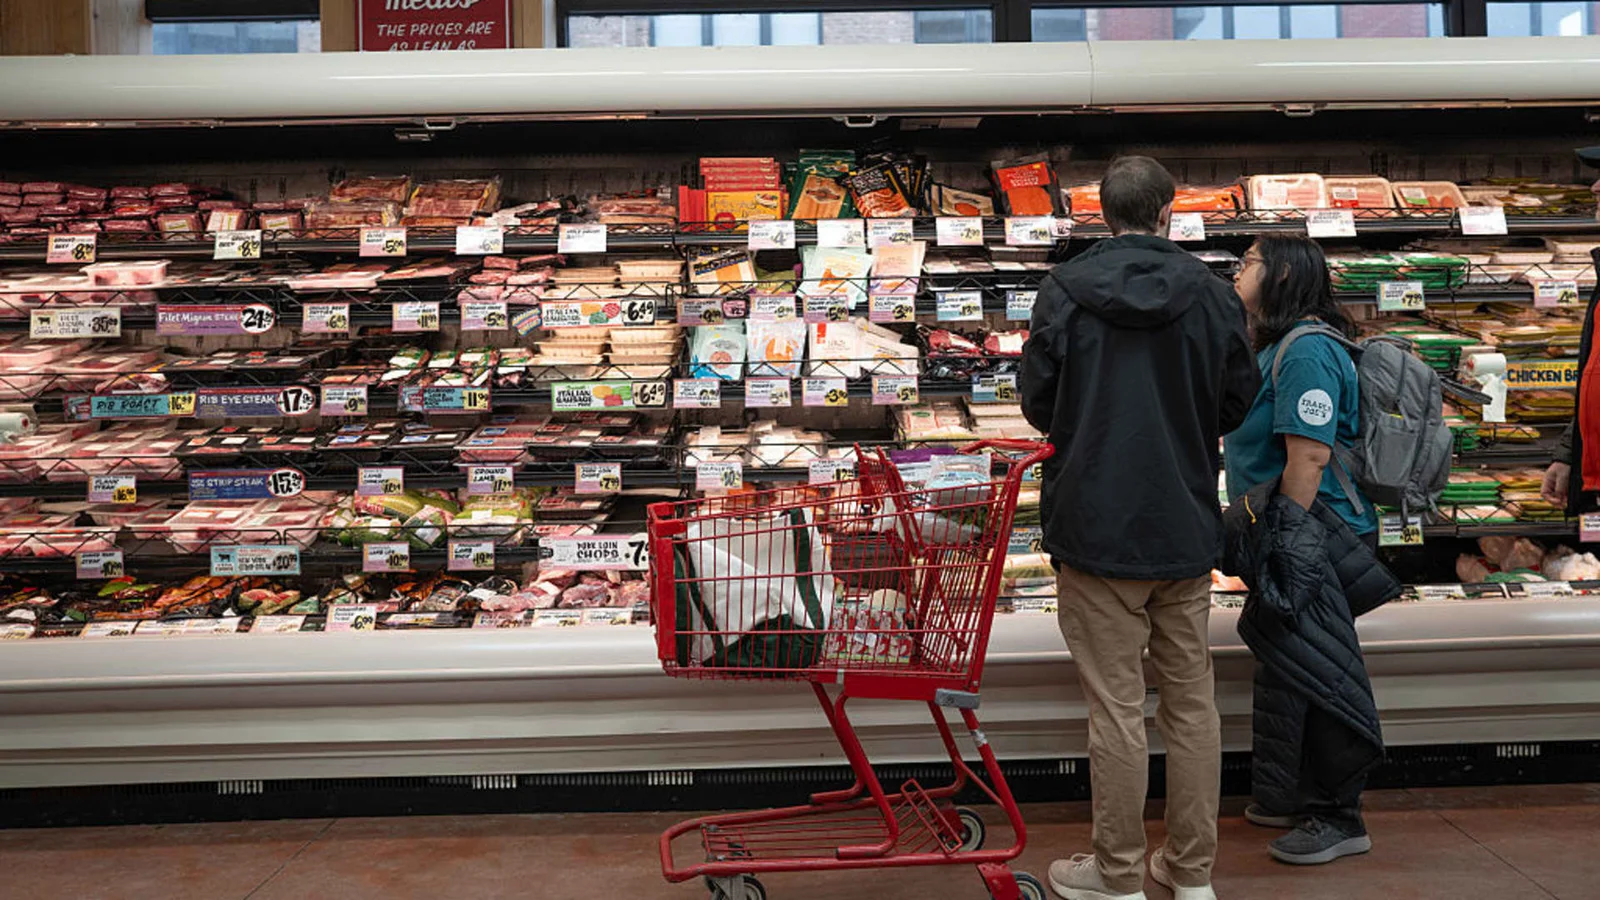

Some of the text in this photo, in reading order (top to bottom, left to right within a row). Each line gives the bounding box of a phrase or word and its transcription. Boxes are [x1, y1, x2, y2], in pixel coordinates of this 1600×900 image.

[376, 21, 495, 36] THE PRICES ARE
[389, 40, 476, 51] AS LEAN AS
[159, 312, 180, 323] Filet
[181, 312, 213, 326] Mignon
[1507, 369, 1562, 382] CHICKEN
[557, 389, 591, 397] ITALIAN
[199, 395, 218, 404] RIB
[221, 395, 241, 404] EYE
[243, 395, 276, 404] STEAK
[234, 478, 264, 487] STEAK
[577, 541, 618, 549] PORK LOIN
[576, 550, 619, 559] CHOPS
